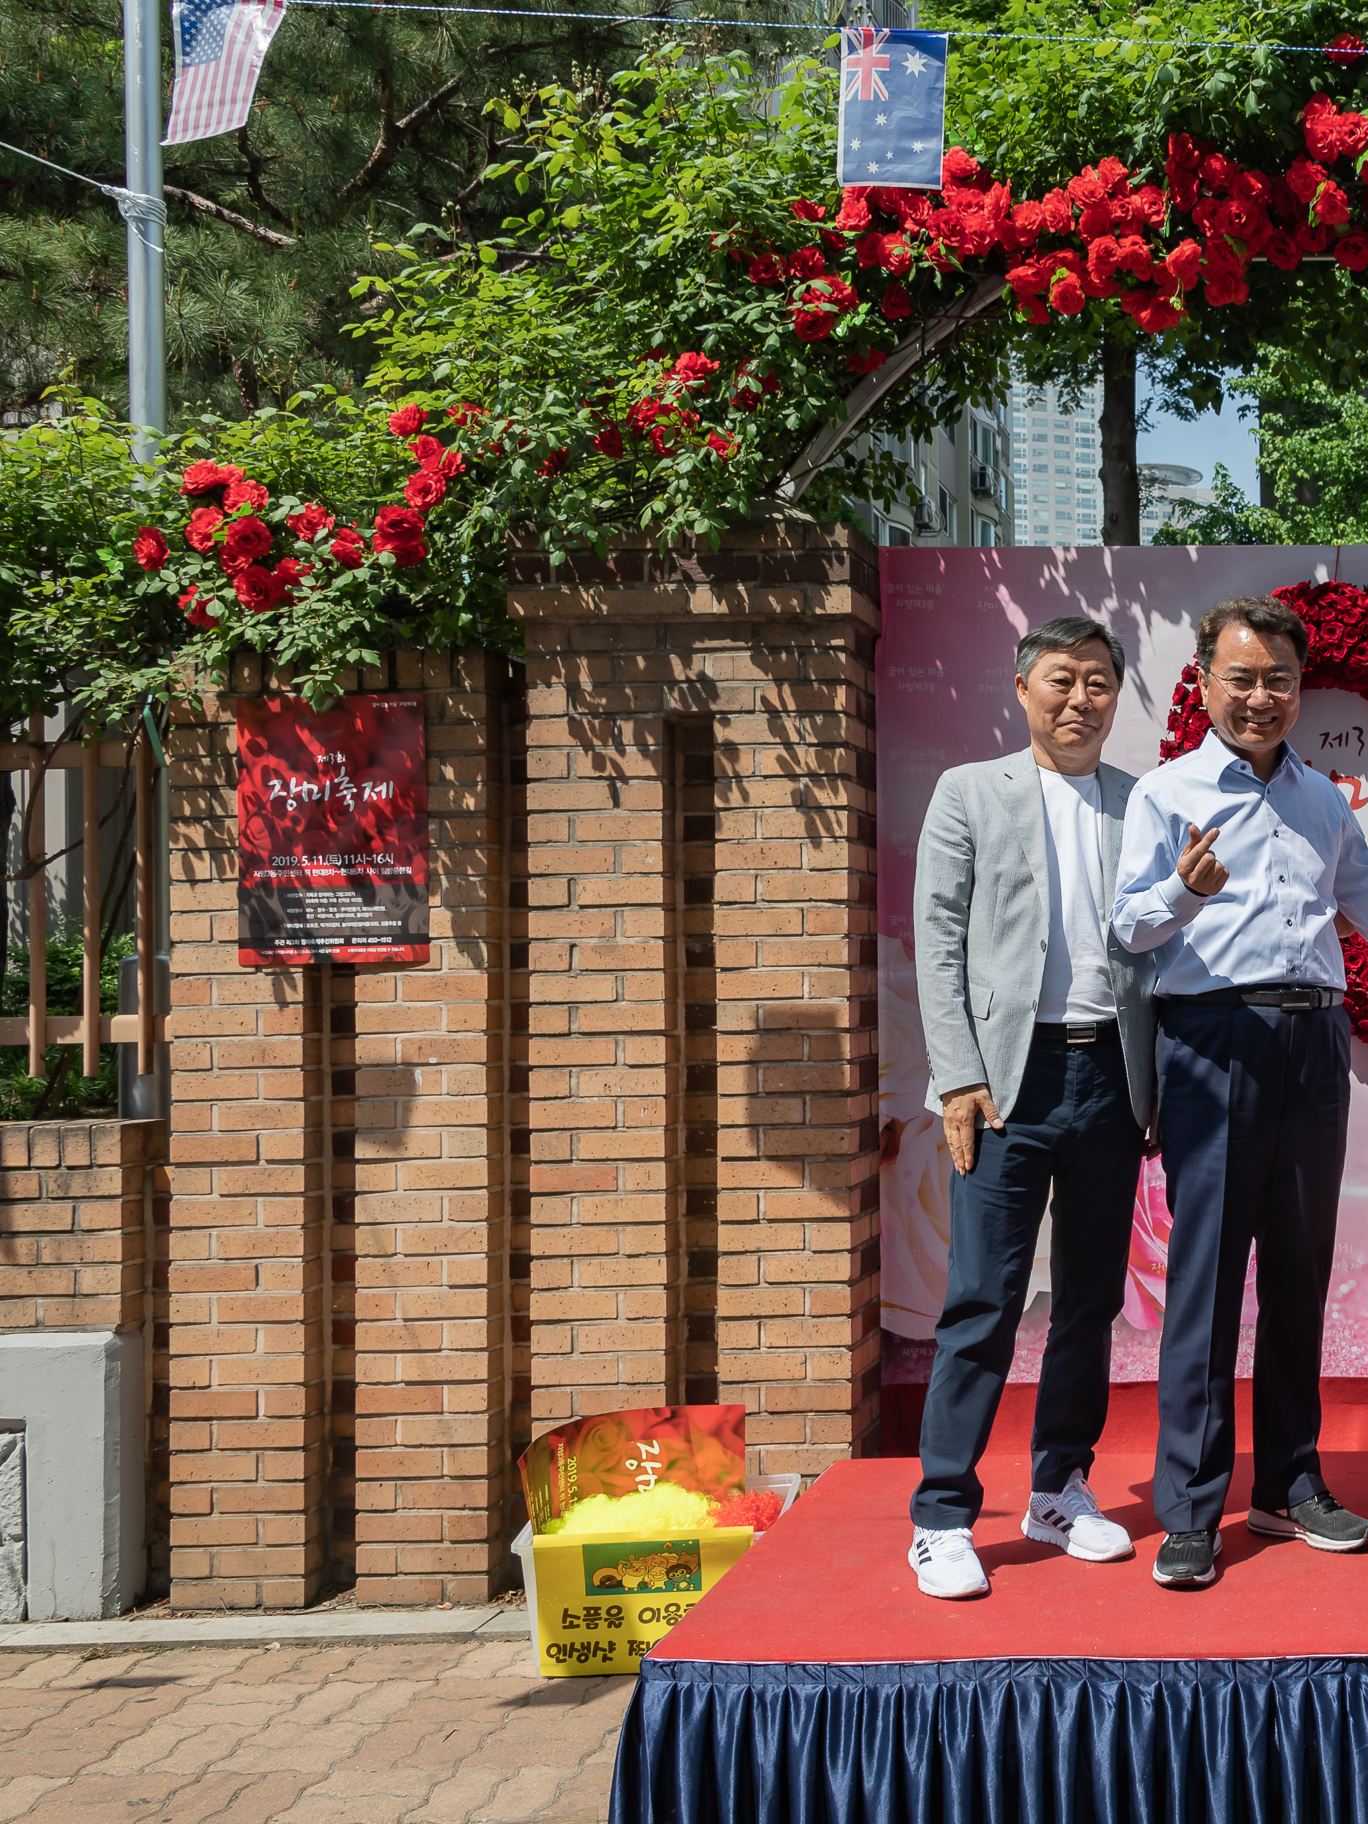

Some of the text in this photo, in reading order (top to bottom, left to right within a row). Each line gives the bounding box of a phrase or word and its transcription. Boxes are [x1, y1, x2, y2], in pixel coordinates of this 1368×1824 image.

[317, 751, 346, 764] 제3회
[267, 766, 394, 811] 장미축제
[344, 853, 394, 865] 11시~16시
[562, 1605, 624, 1630] 소품을
[546, 1640, 617, 1664] 인생샷
